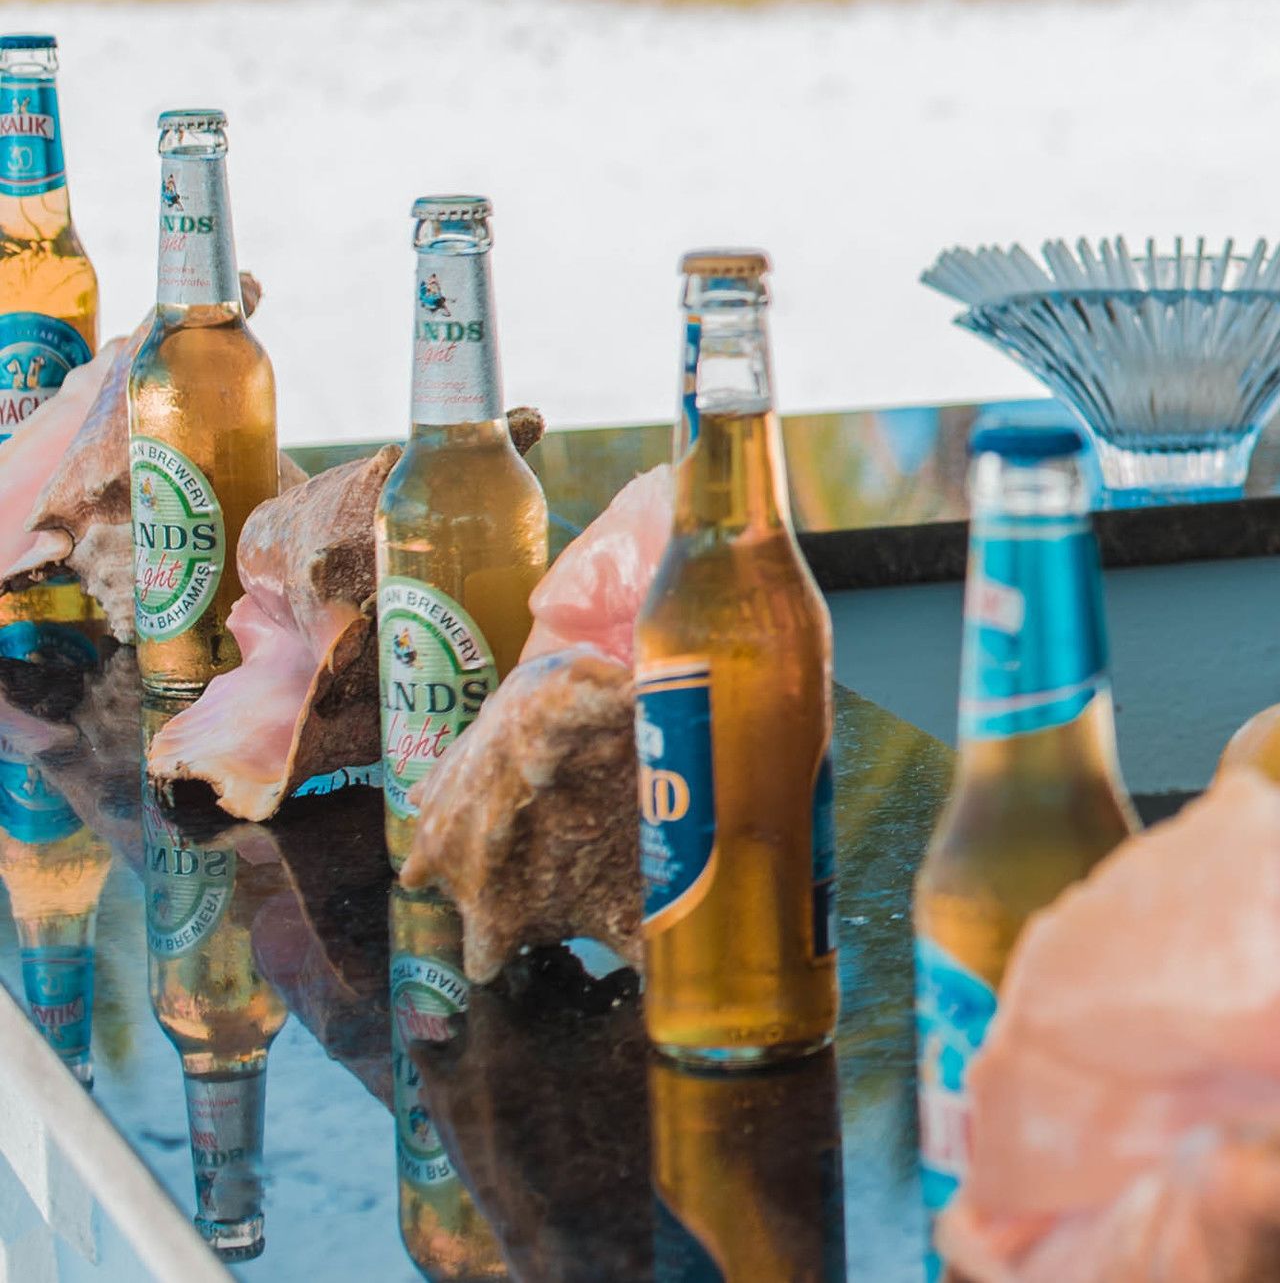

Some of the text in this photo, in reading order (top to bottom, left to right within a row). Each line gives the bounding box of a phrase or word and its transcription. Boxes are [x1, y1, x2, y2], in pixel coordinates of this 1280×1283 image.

[160, 215, 214, 233] NDS
[417, 320, 484, 342] NDS
[148, 445, 209, 508] BREWERY
[157, 563, 211, 630] BAHAMAS
[406, 589, 480, 663] BREWERY
[386, 713, 451, 776] Light
